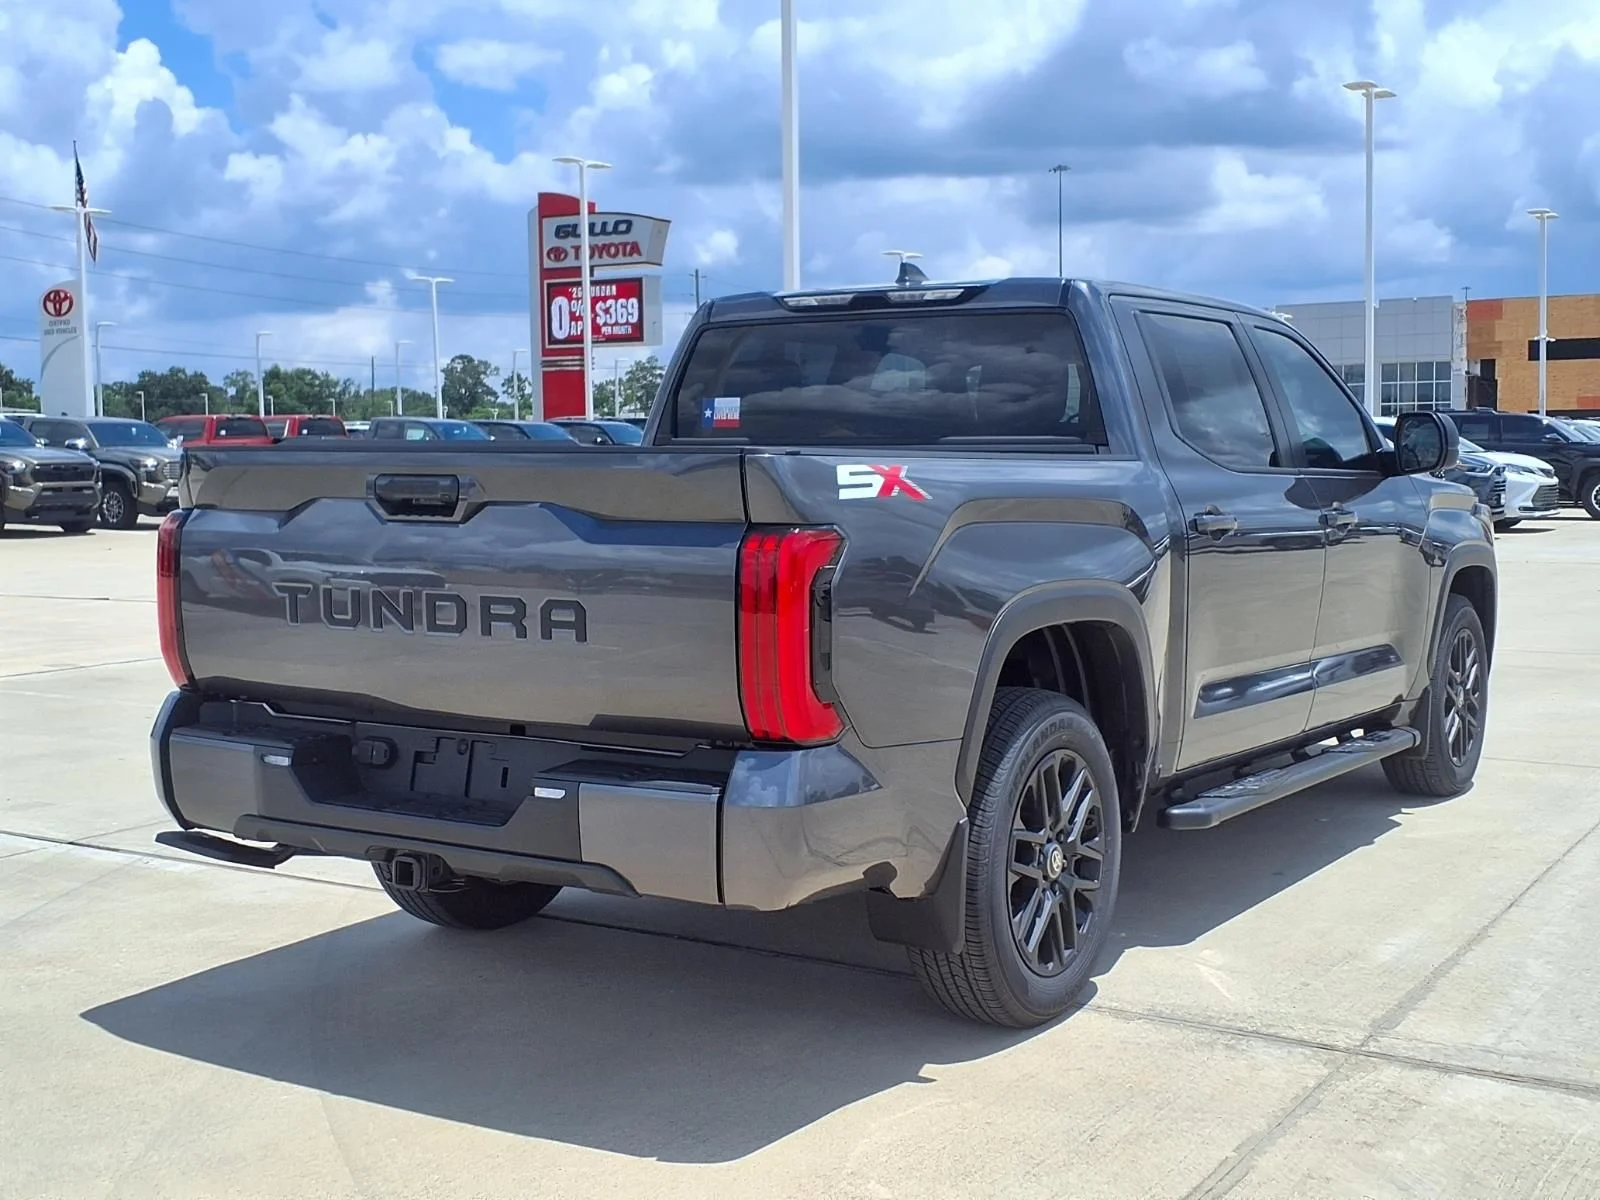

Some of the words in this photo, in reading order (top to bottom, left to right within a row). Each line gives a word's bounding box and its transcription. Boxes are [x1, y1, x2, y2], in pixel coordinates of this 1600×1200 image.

[570, 241, 642, 261] TOYOTA
[595, 297, 639, 326] $369
[570, 321, 584, 336] AP
[272, 581, 588, 645] TUNDRA
